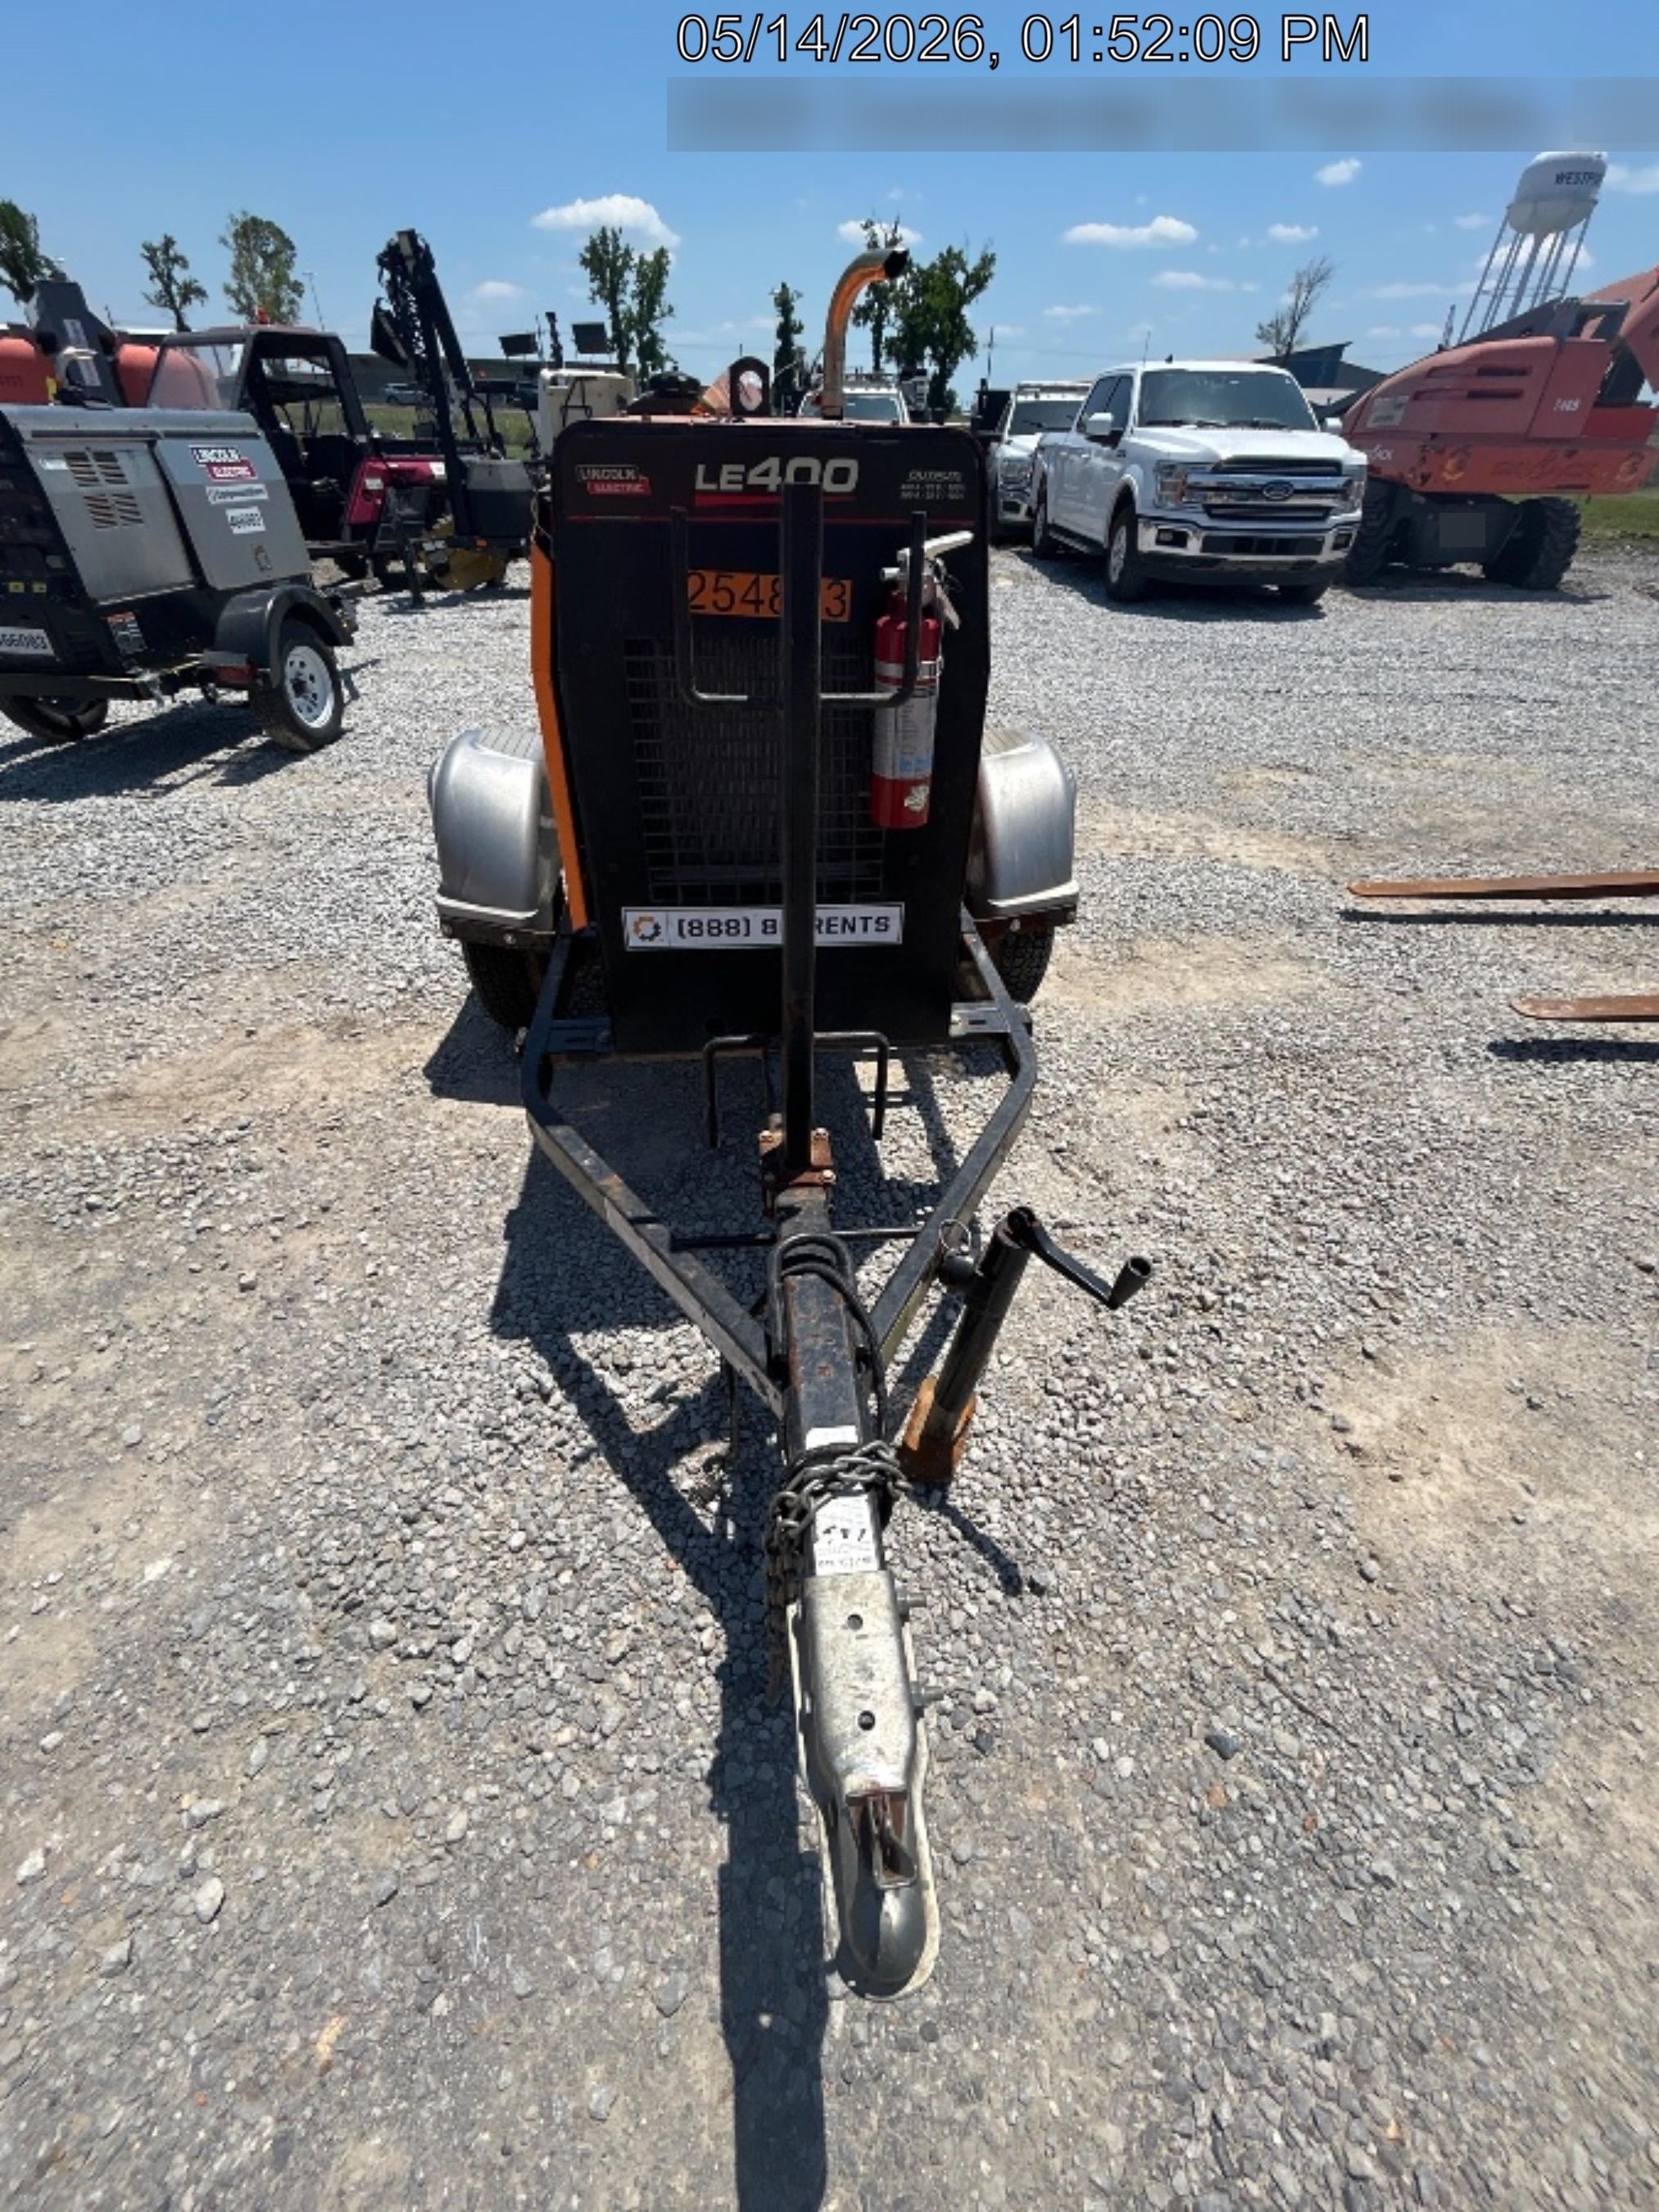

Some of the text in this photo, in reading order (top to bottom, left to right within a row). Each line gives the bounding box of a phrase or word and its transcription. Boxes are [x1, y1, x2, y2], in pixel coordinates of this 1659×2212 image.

[578, 468, 637, 481] LINCOLN
[695, 456, 859, 492] LE400
[592, 483, 646, 492] ELECTRIC
[687, 573, 846, 618] 25483
[0, 632, 48, 650] 66083
